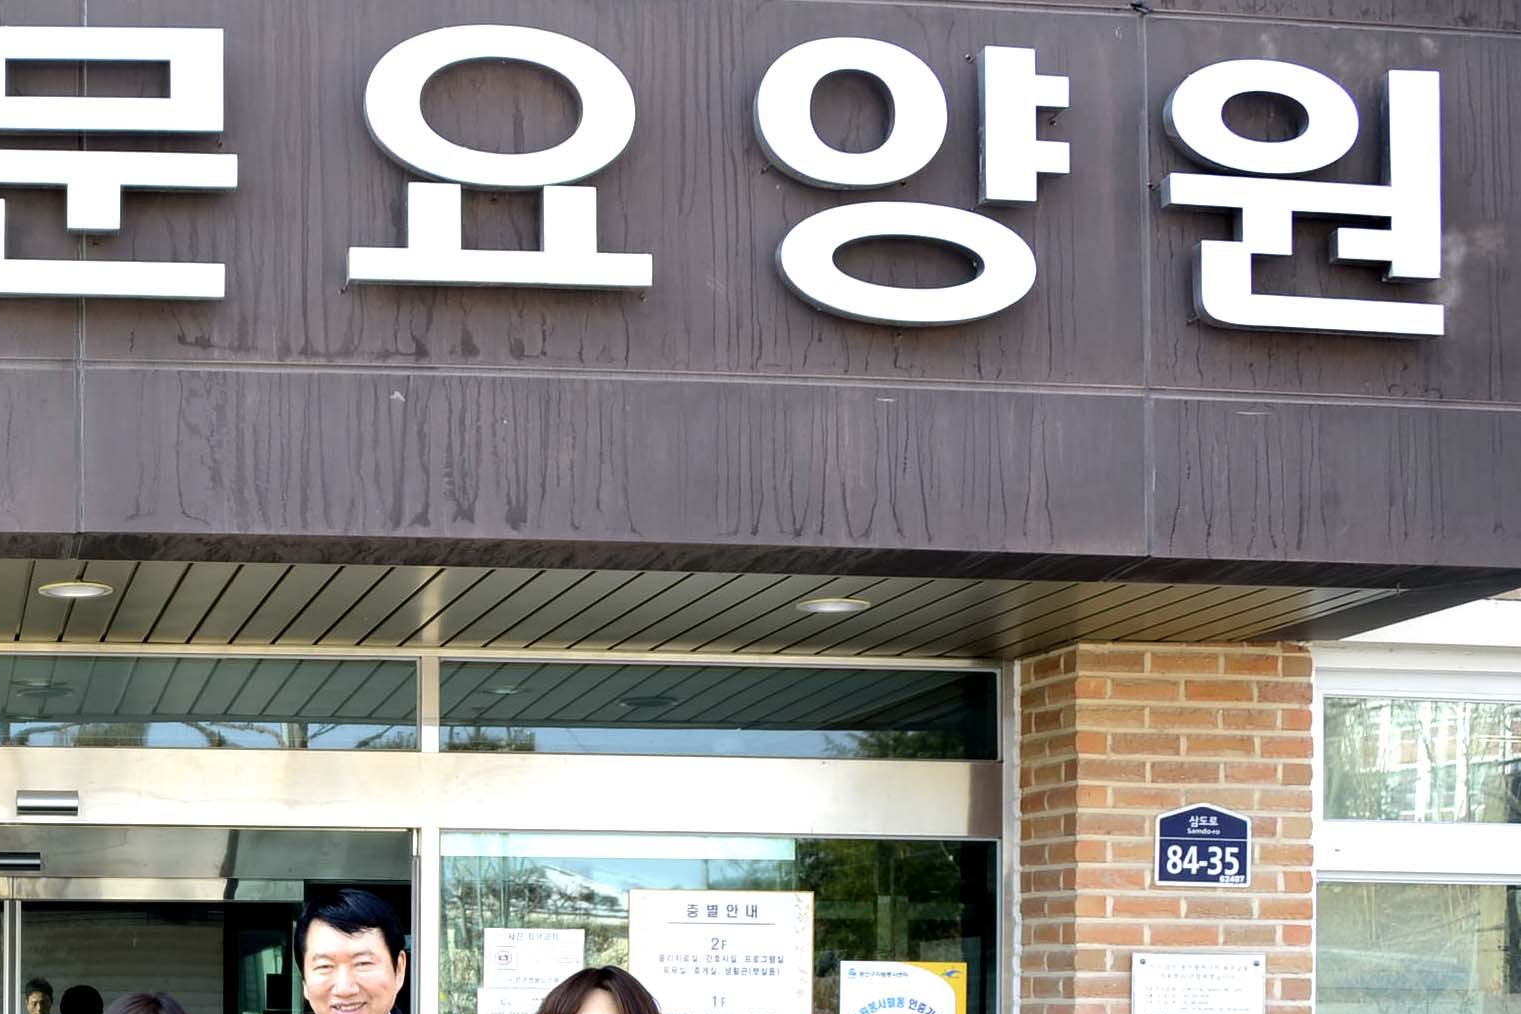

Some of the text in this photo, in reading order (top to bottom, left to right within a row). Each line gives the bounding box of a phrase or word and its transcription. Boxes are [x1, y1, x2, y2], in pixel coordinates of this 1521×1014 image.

[1189, 815, 1219, 828] 삼도로
[1166, 844, 1240, 876] 84-35
[710, 937, 727, 951] 2F
[711, 995, 727, 1008] 1F
